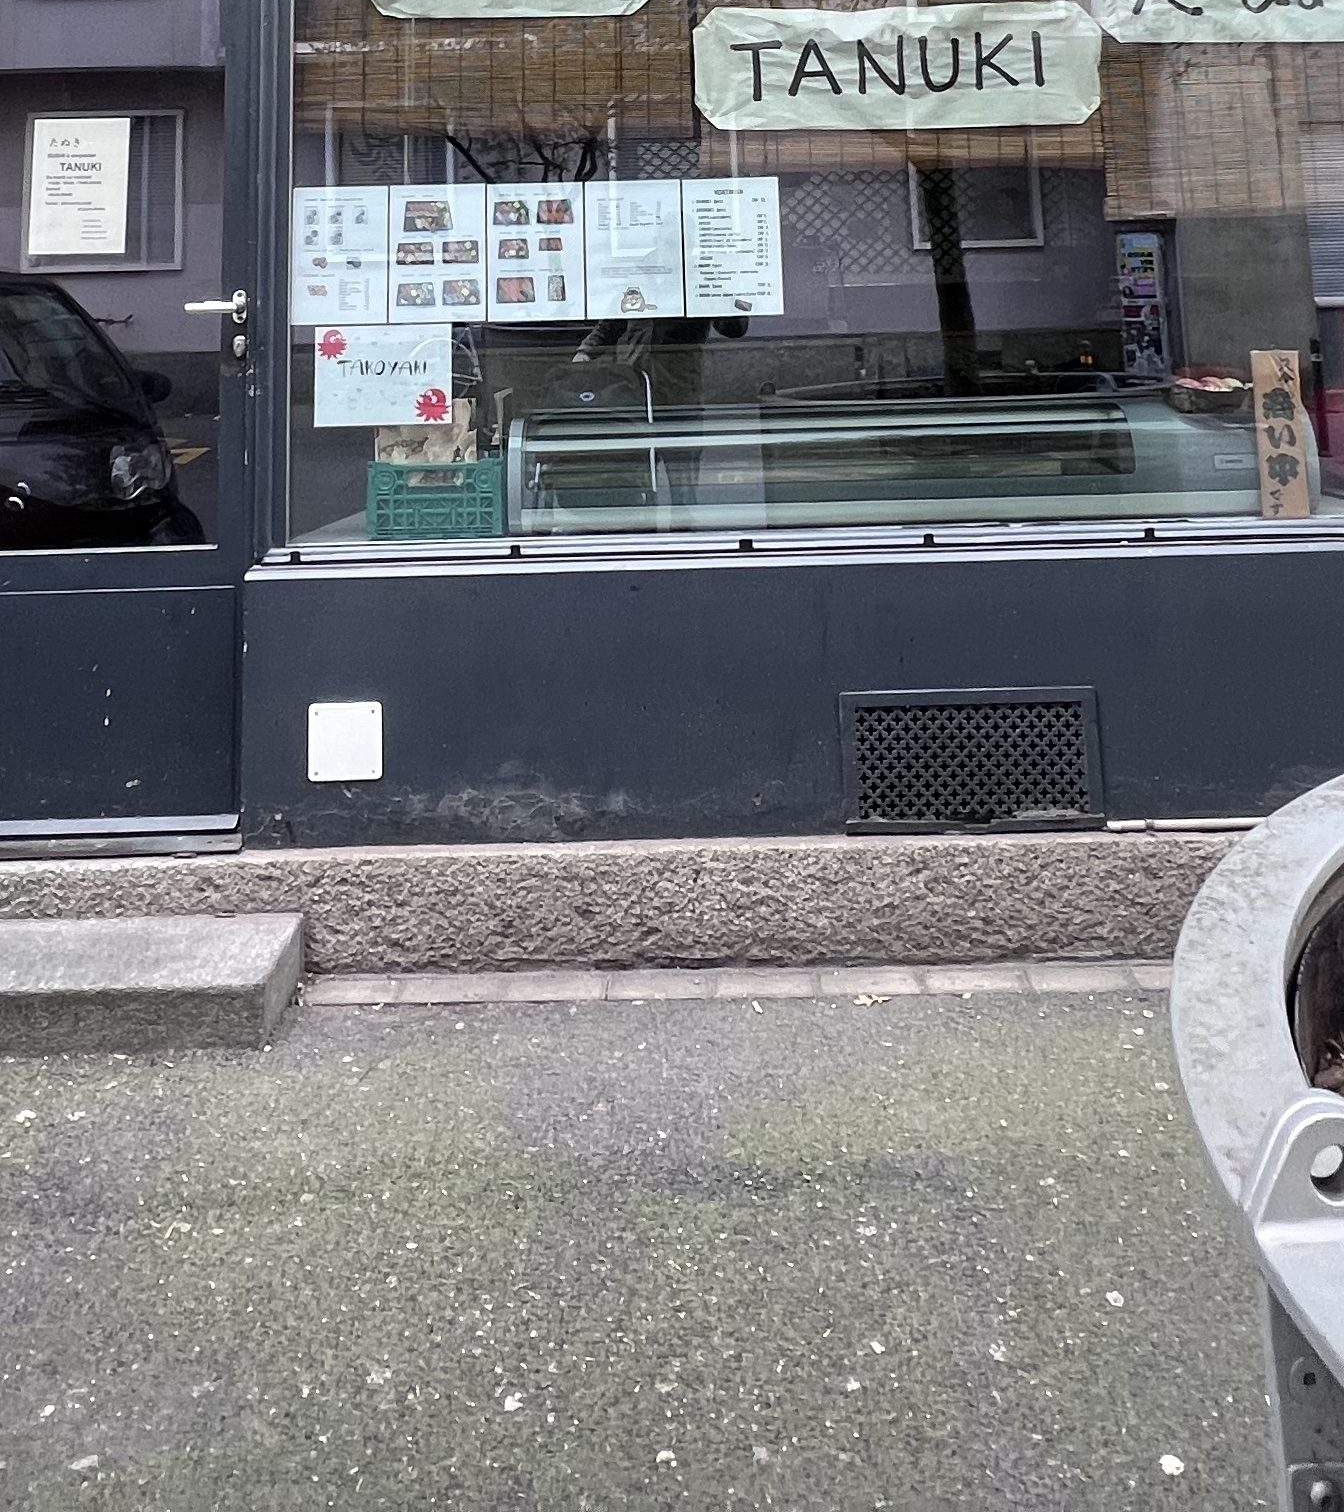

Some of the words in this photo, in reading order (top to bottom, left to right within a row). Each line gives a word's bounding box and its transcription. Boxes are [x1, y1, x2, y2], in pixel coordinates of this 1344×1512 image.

[730, 30, 1045, 102] TANUKI
[49, 137, 80, 148] たぬき
[59, 162, 102, 172] TANUKI
[337, 358, 427, 377] TAKOYAKI
